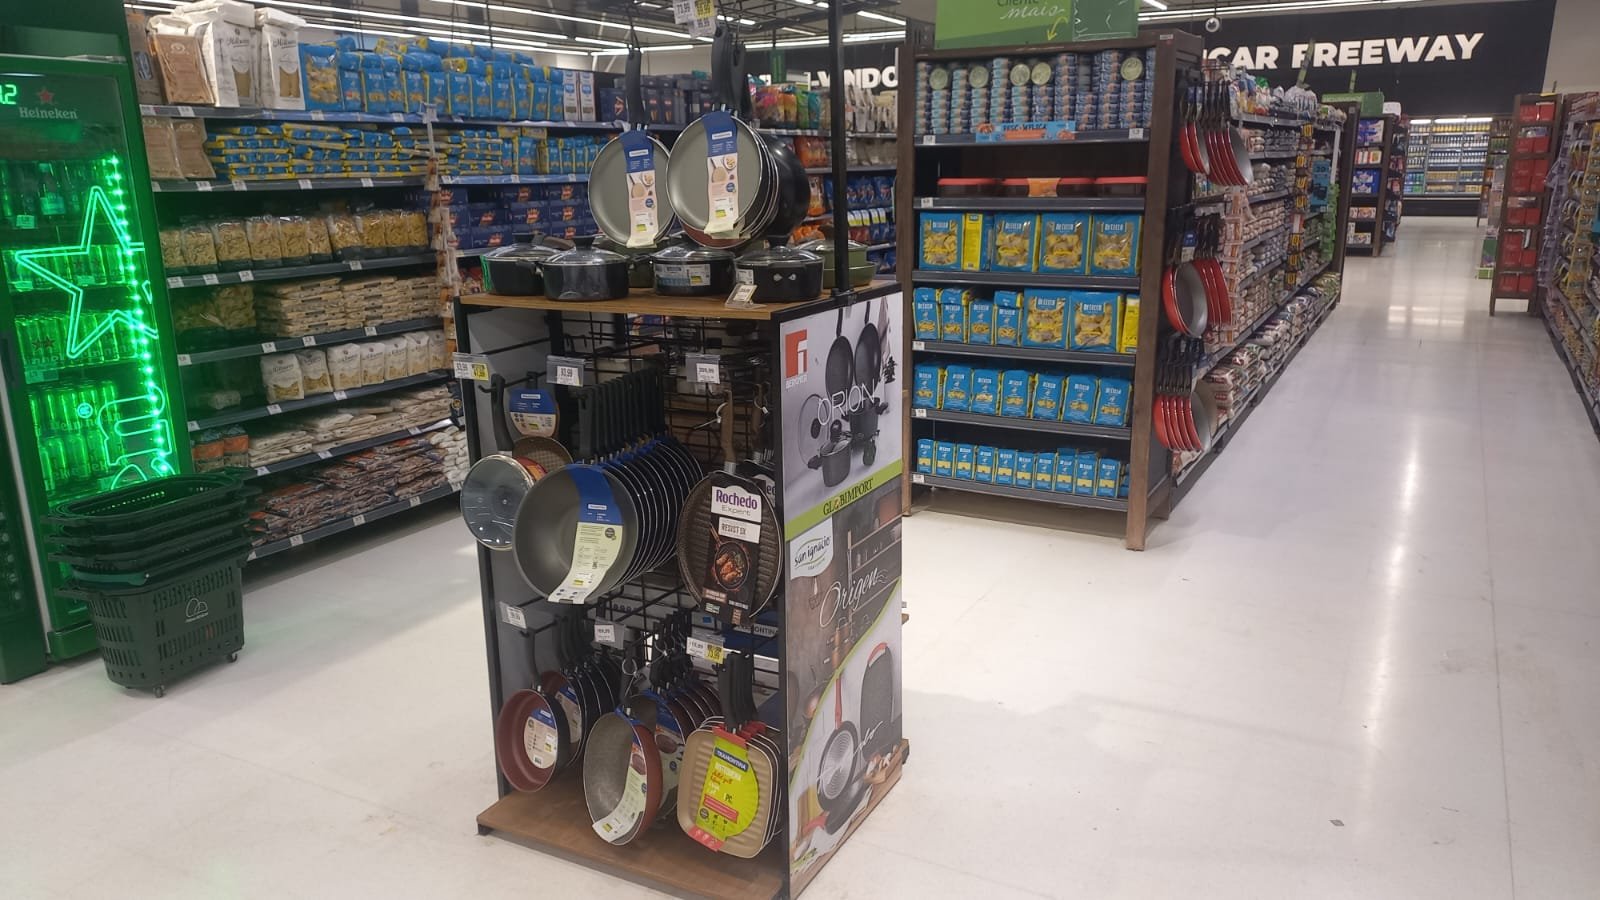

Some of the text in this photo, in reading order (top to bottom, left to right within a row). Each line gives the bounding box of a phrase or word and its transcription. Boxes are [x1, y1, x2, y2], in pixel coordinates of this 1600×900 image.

[1291, 33, 1485, 69] FREEWAY
[19, 106, 78, 120] Heineken
[817, 379, 875, 426] ORION
[716, 489, 758, 510] Rochedo
[820, 567, 888, 628] Origen
